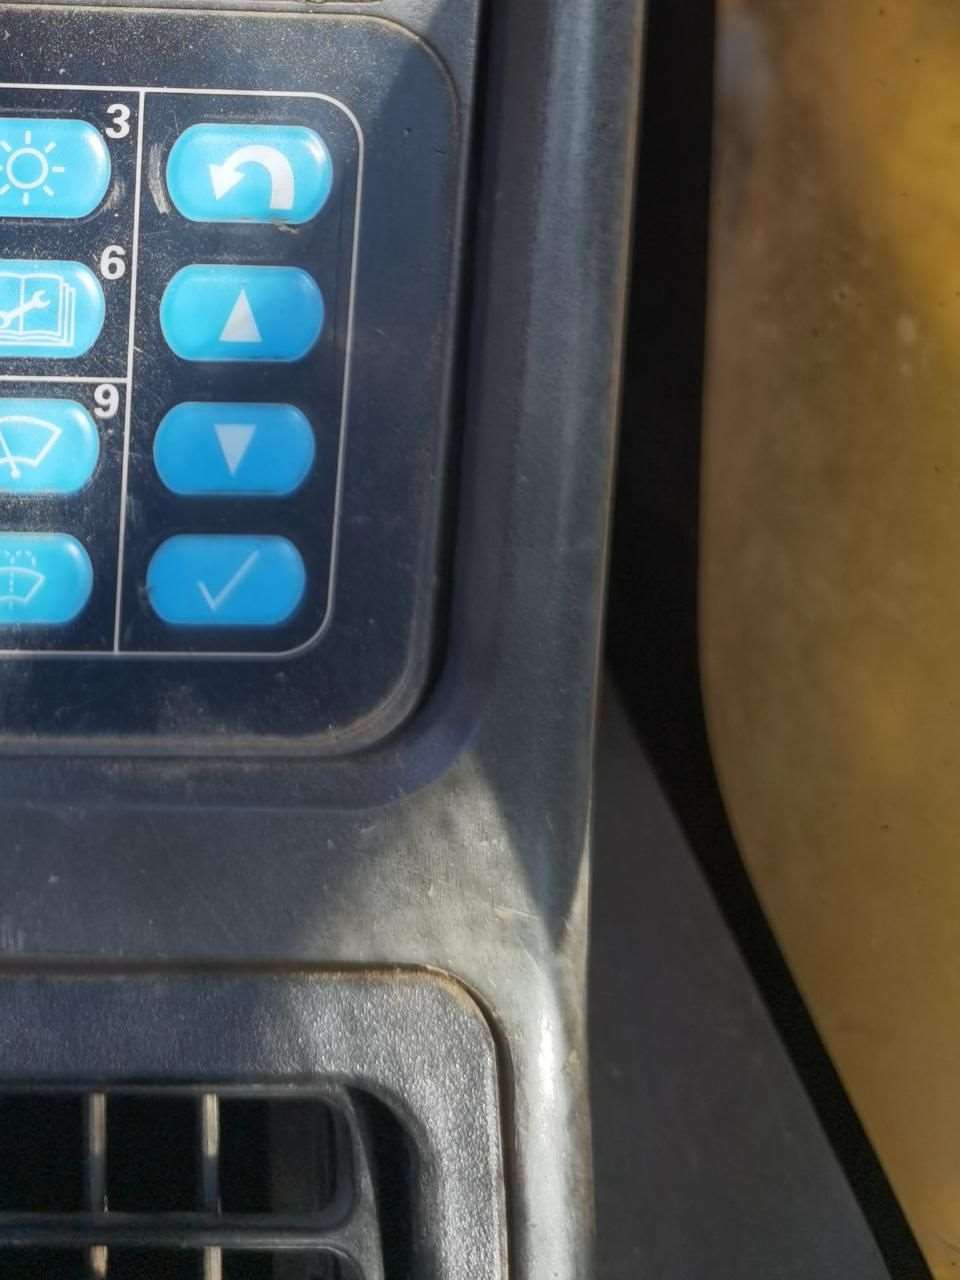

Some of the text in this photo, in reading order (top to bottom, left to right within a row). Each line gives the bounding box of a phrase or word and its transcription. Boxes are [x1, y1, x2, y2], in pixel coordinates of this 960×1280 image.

[104, 103, 131, 139] 3
[99, 244, 126, 280] 6
[93, 383, 120, 419] 9
